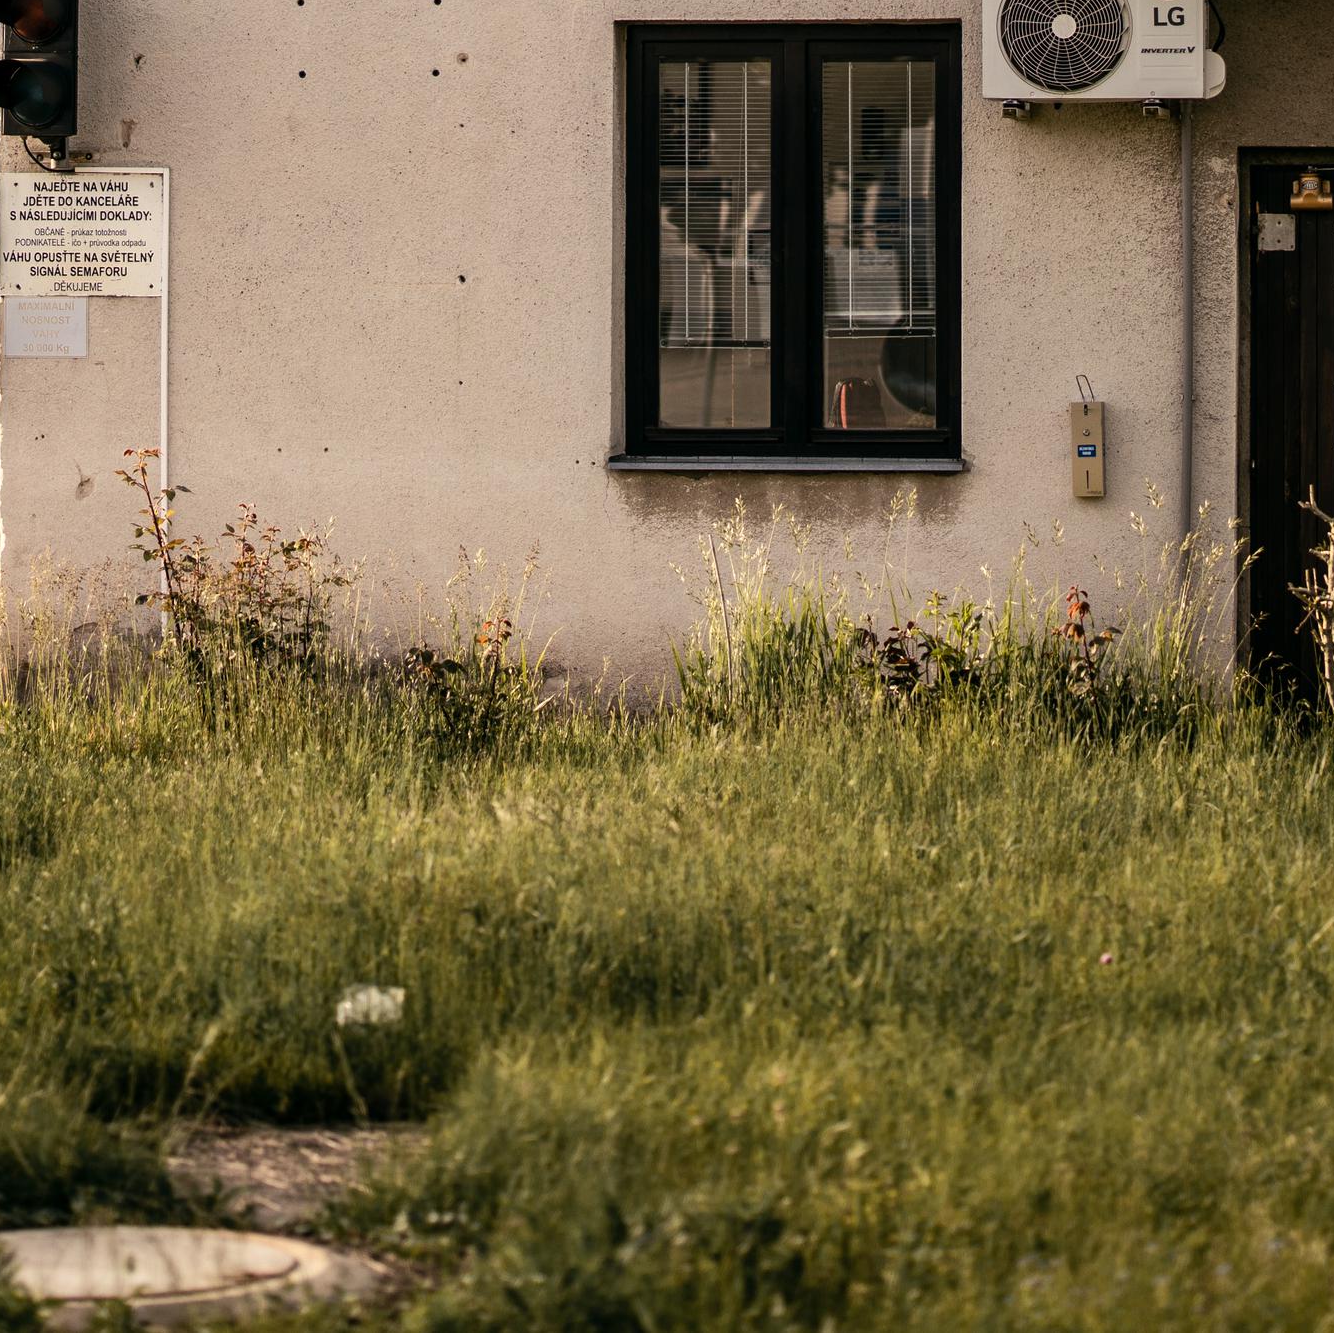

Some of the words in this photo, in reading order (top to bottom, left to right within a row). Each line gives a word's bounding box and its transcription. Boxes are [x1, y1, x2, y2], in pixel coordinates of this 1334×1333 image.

[1153, 6, 1186, 27] LG
[34, 179, 80, 192] NAJEĎTE
[83, 181, 98, 192] NA
[100, 179, 129, 192] VÁHU
[23, 195, 55, 207] JDĚTE
[58, 196, 73, 207] DO
[76, 194, 139, 207] KANCELÁŘE
[10, 210, 17, 221] S
[19, 209, 97, 221] NÁSLEDUJÍCÍMI
[101, 210, 152, 221] DOKLADY:
[3, 250, 31, 262] VÁHU
[34, 251, 81, 263] OPUSŤTE
[84, 252, 98, 262] NA
[101, 250, 154, 263] SVĚTELNÝ
[30, 265, 68, 277] SIGNÁL
[70, 266, 128, 277] SEMAFORU
[53, 280, 103, 292] DĚKUJEME
